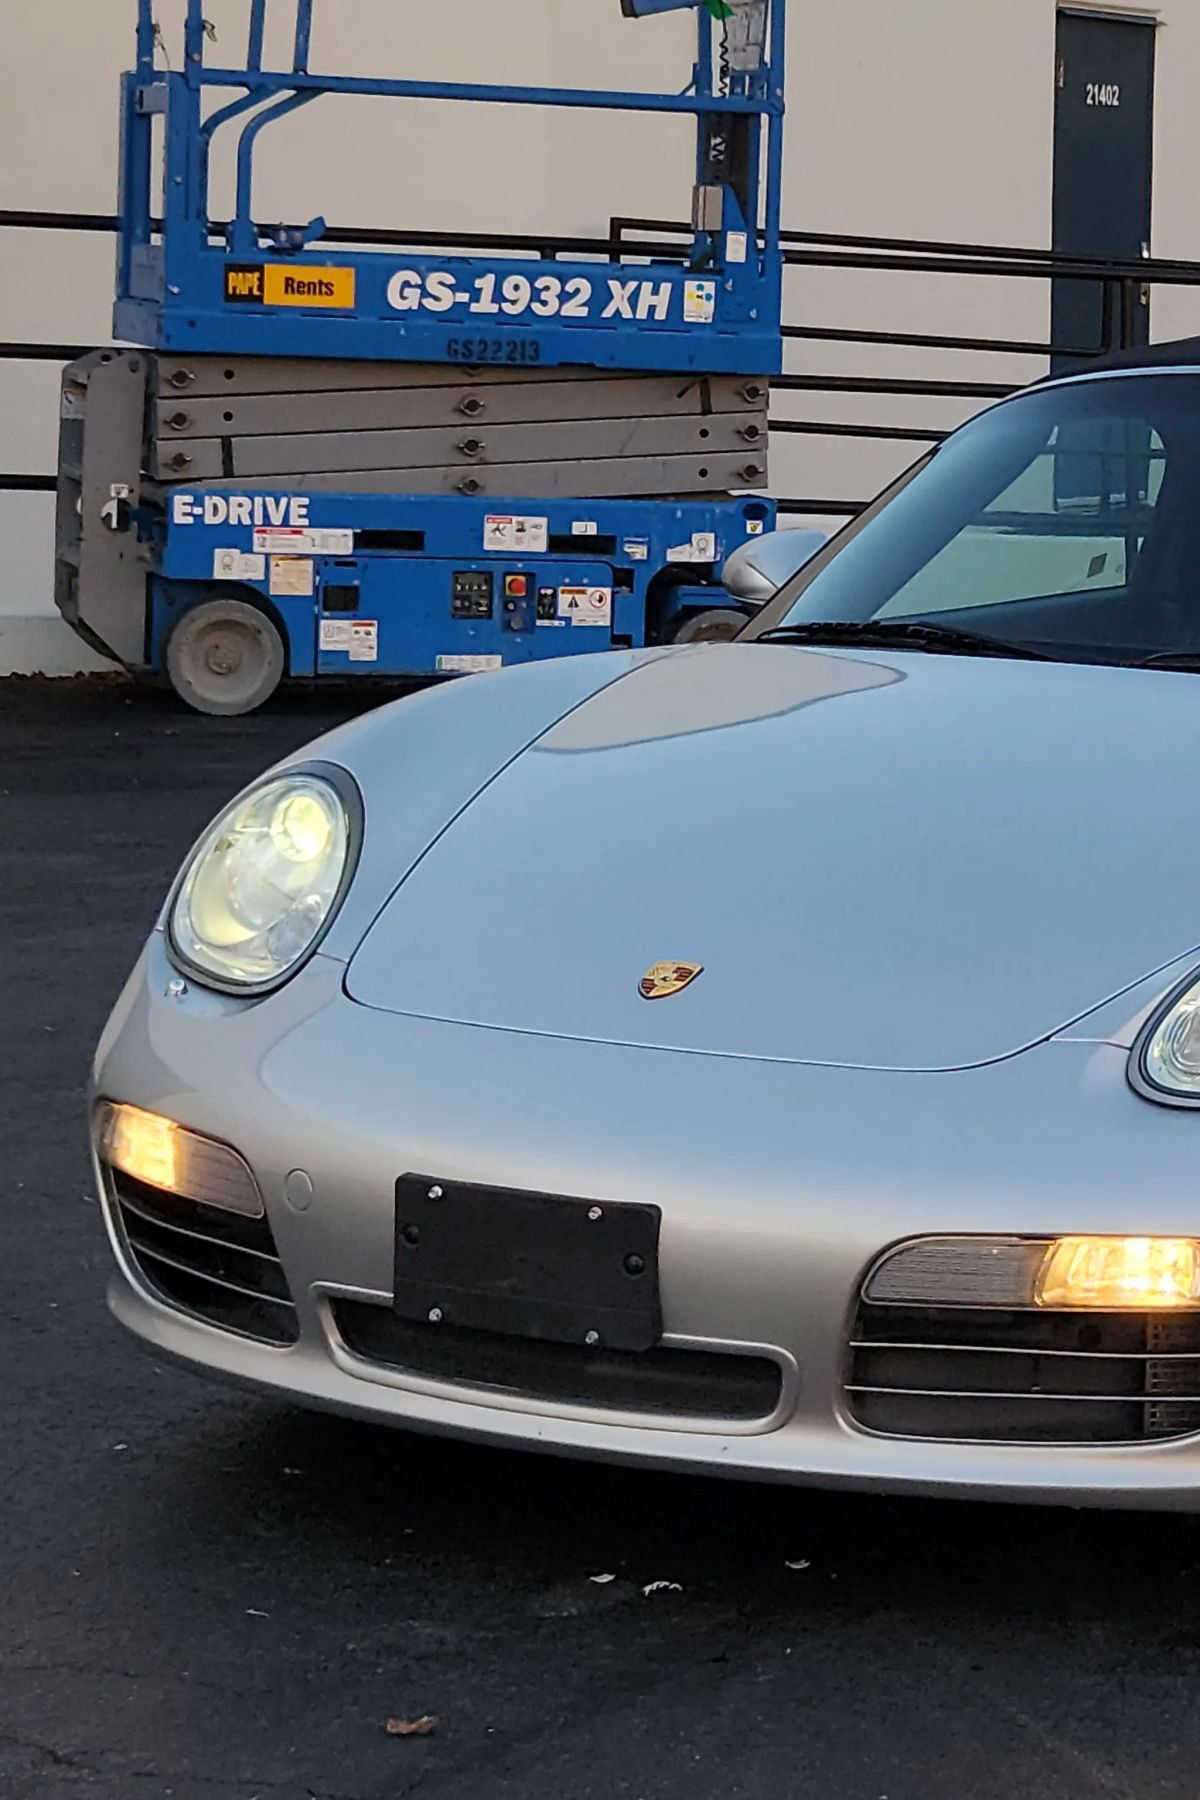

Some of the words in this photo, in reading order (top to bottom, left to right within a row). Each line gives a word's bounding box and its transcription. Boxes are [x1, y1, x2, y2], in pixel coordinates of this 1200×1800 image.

[1086, 83, 1120, 106] 21402
[284, 276, 335, 297] Rents
[386, 269, 592, 317] GS-1932
[600, 279, 673, 320] XH
[447, 338, 540, 362] GS22213
[173, 495, 310, 526] E-DRIVE
